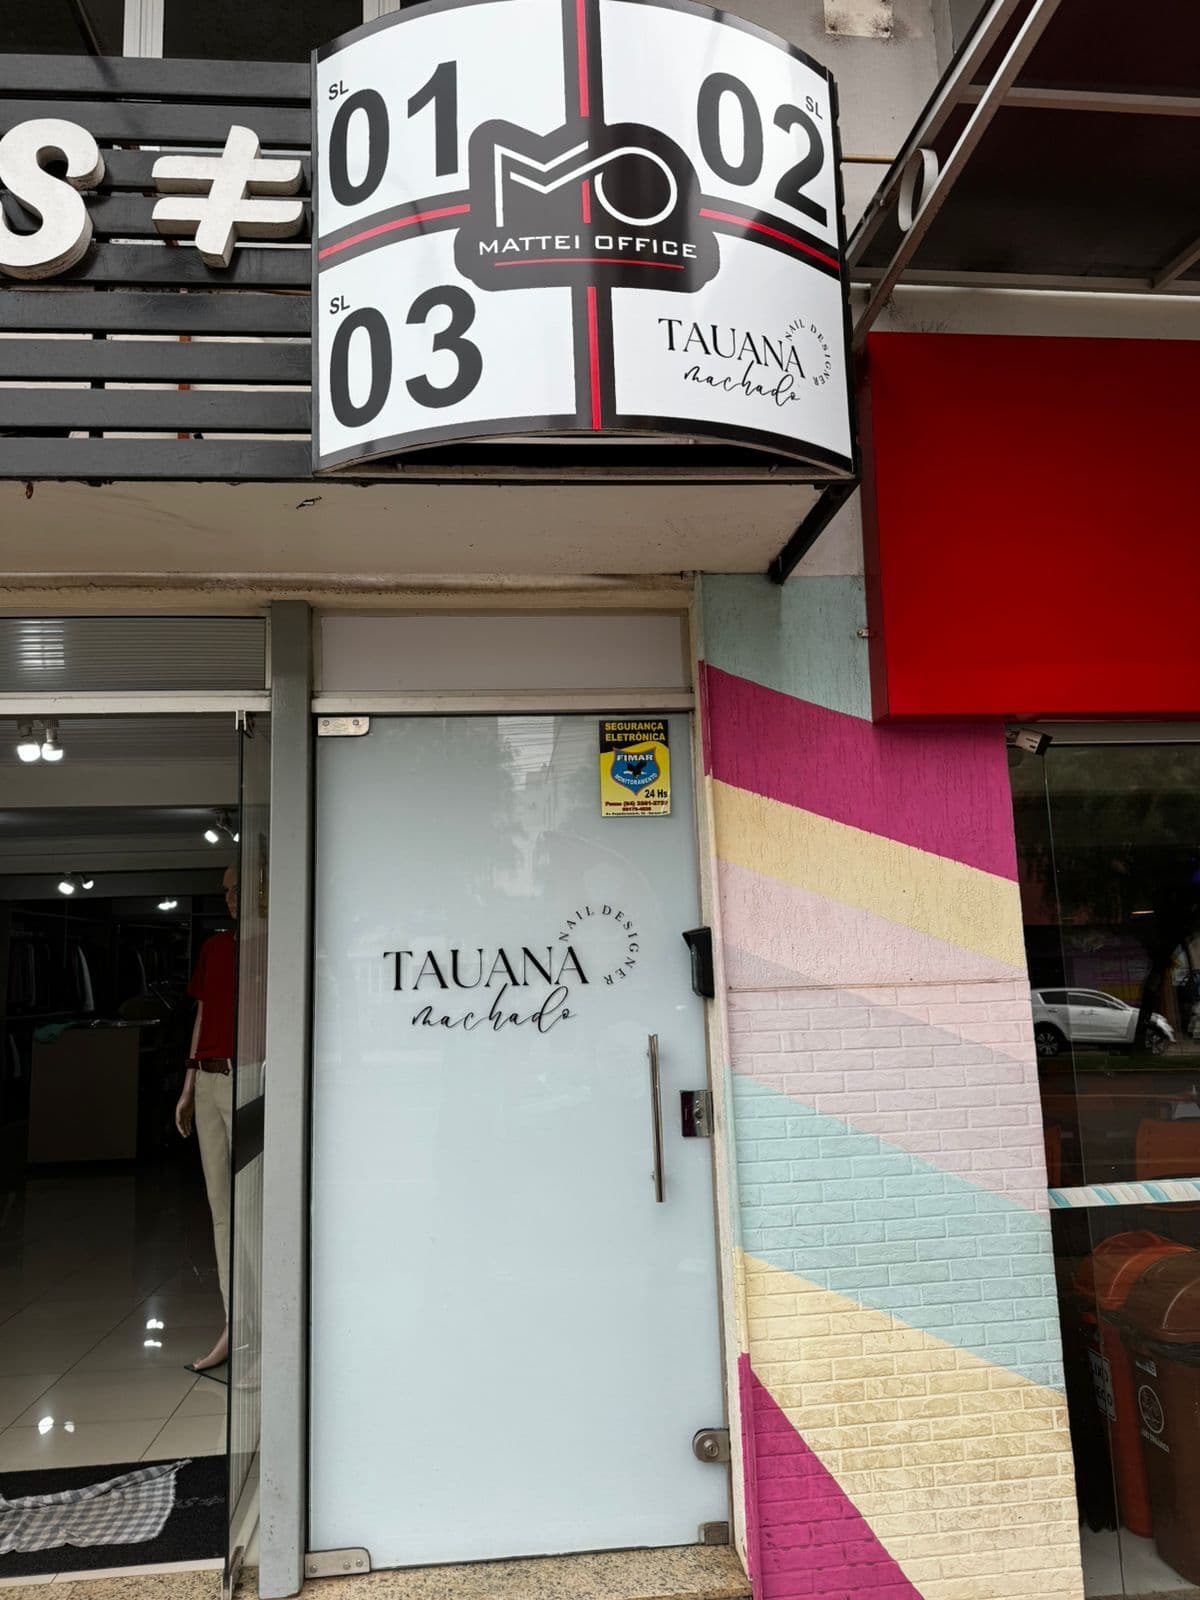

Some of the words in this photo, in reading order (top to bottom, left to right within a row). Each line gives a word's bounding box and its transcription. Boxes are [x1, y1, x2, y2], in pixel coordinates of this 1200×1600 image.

[328, 80, 349, 101] SL
[805, 95, 823, 120] SL
[329, 60, 458, 207] 01
[696, 72, 828, 228] 02
[479, 234, 581, 256] MATTEI
[594, 234, 698, 259] OFFICE
[329, 295, 351, 315] SL
[329, 284, 483, 428] 03
[657, 317, 806, 379] TAUANA
[784, 317, 806, 342] NAIL
[809, 323, 833, 387] DESIGNER
[683, 359, 801, 407] machado
[604, 722, 664, 732] SEGURANÇA
[644, 789, 655, 798] 24
[657, 789, 668, 798] Hs
[382, 945, 590, 991] TAUANA
[558, 904, 595, 942] NAIL
[601, 903, 640, 985] DESIGNER
[411, 982, 577, 1033] machado
